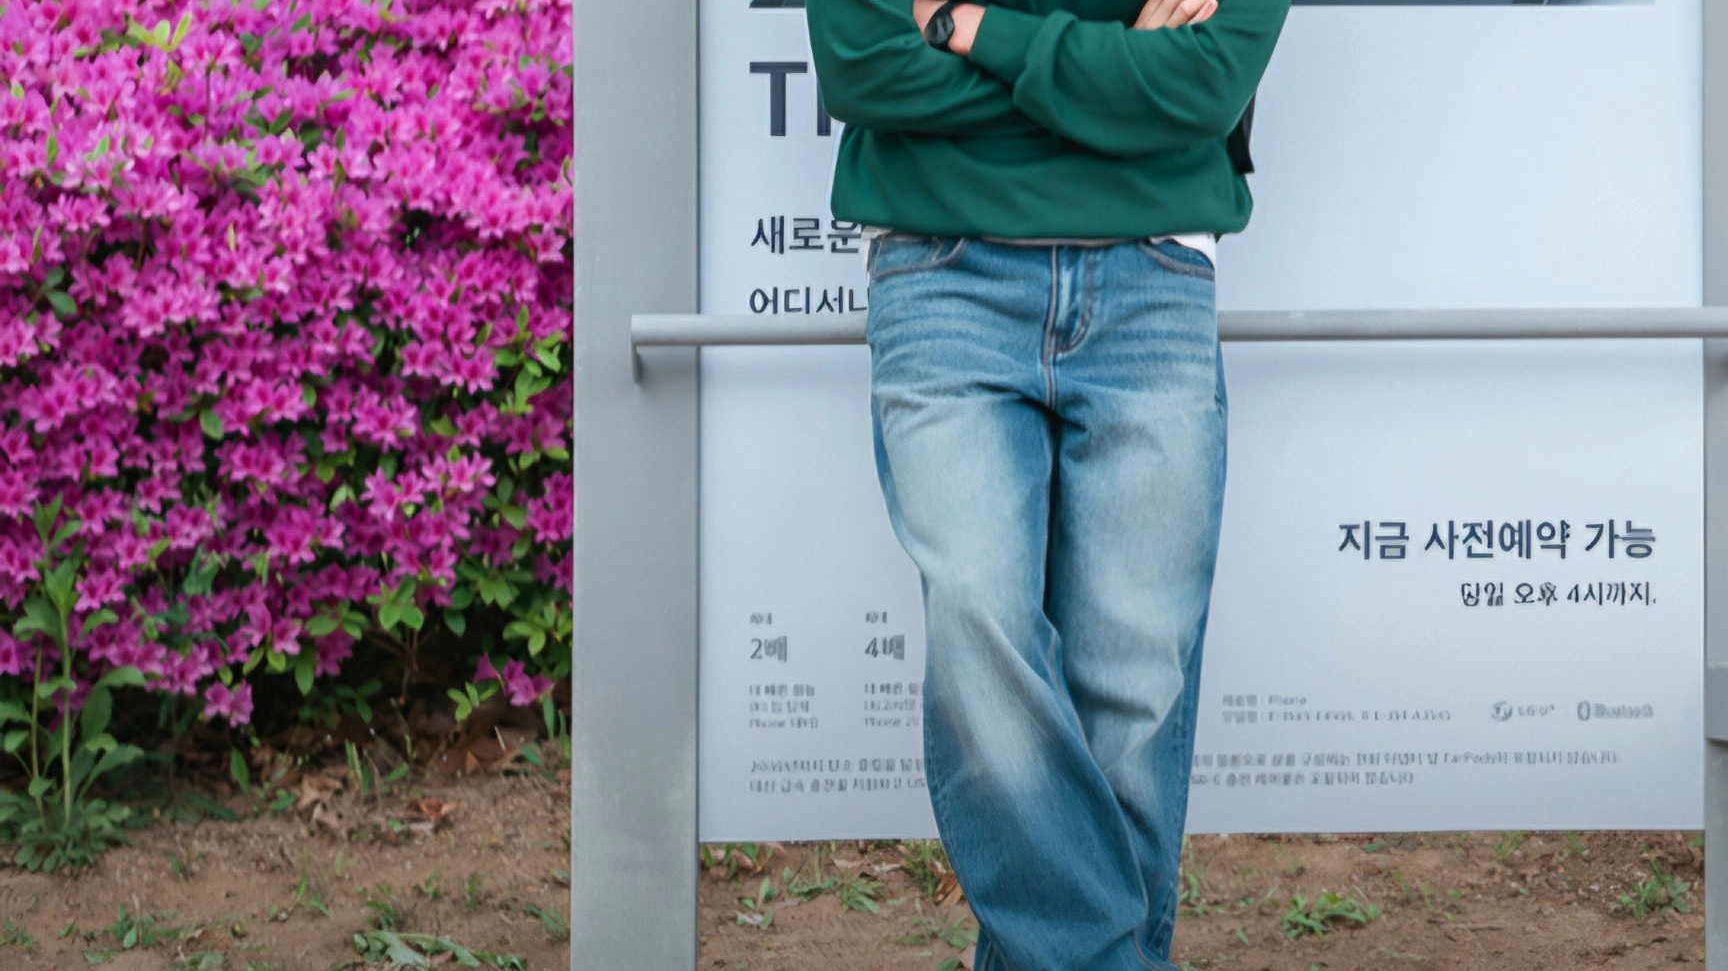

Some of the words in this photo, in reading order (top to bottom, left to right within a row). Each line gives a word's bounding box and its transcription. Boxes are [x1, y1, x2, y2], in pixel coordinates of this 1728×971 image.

[1338, 520, 1410, 559] 지금
[1424, 520, 1571, 559] 사전예약
[1584, 518, 1656, 559] 가능
